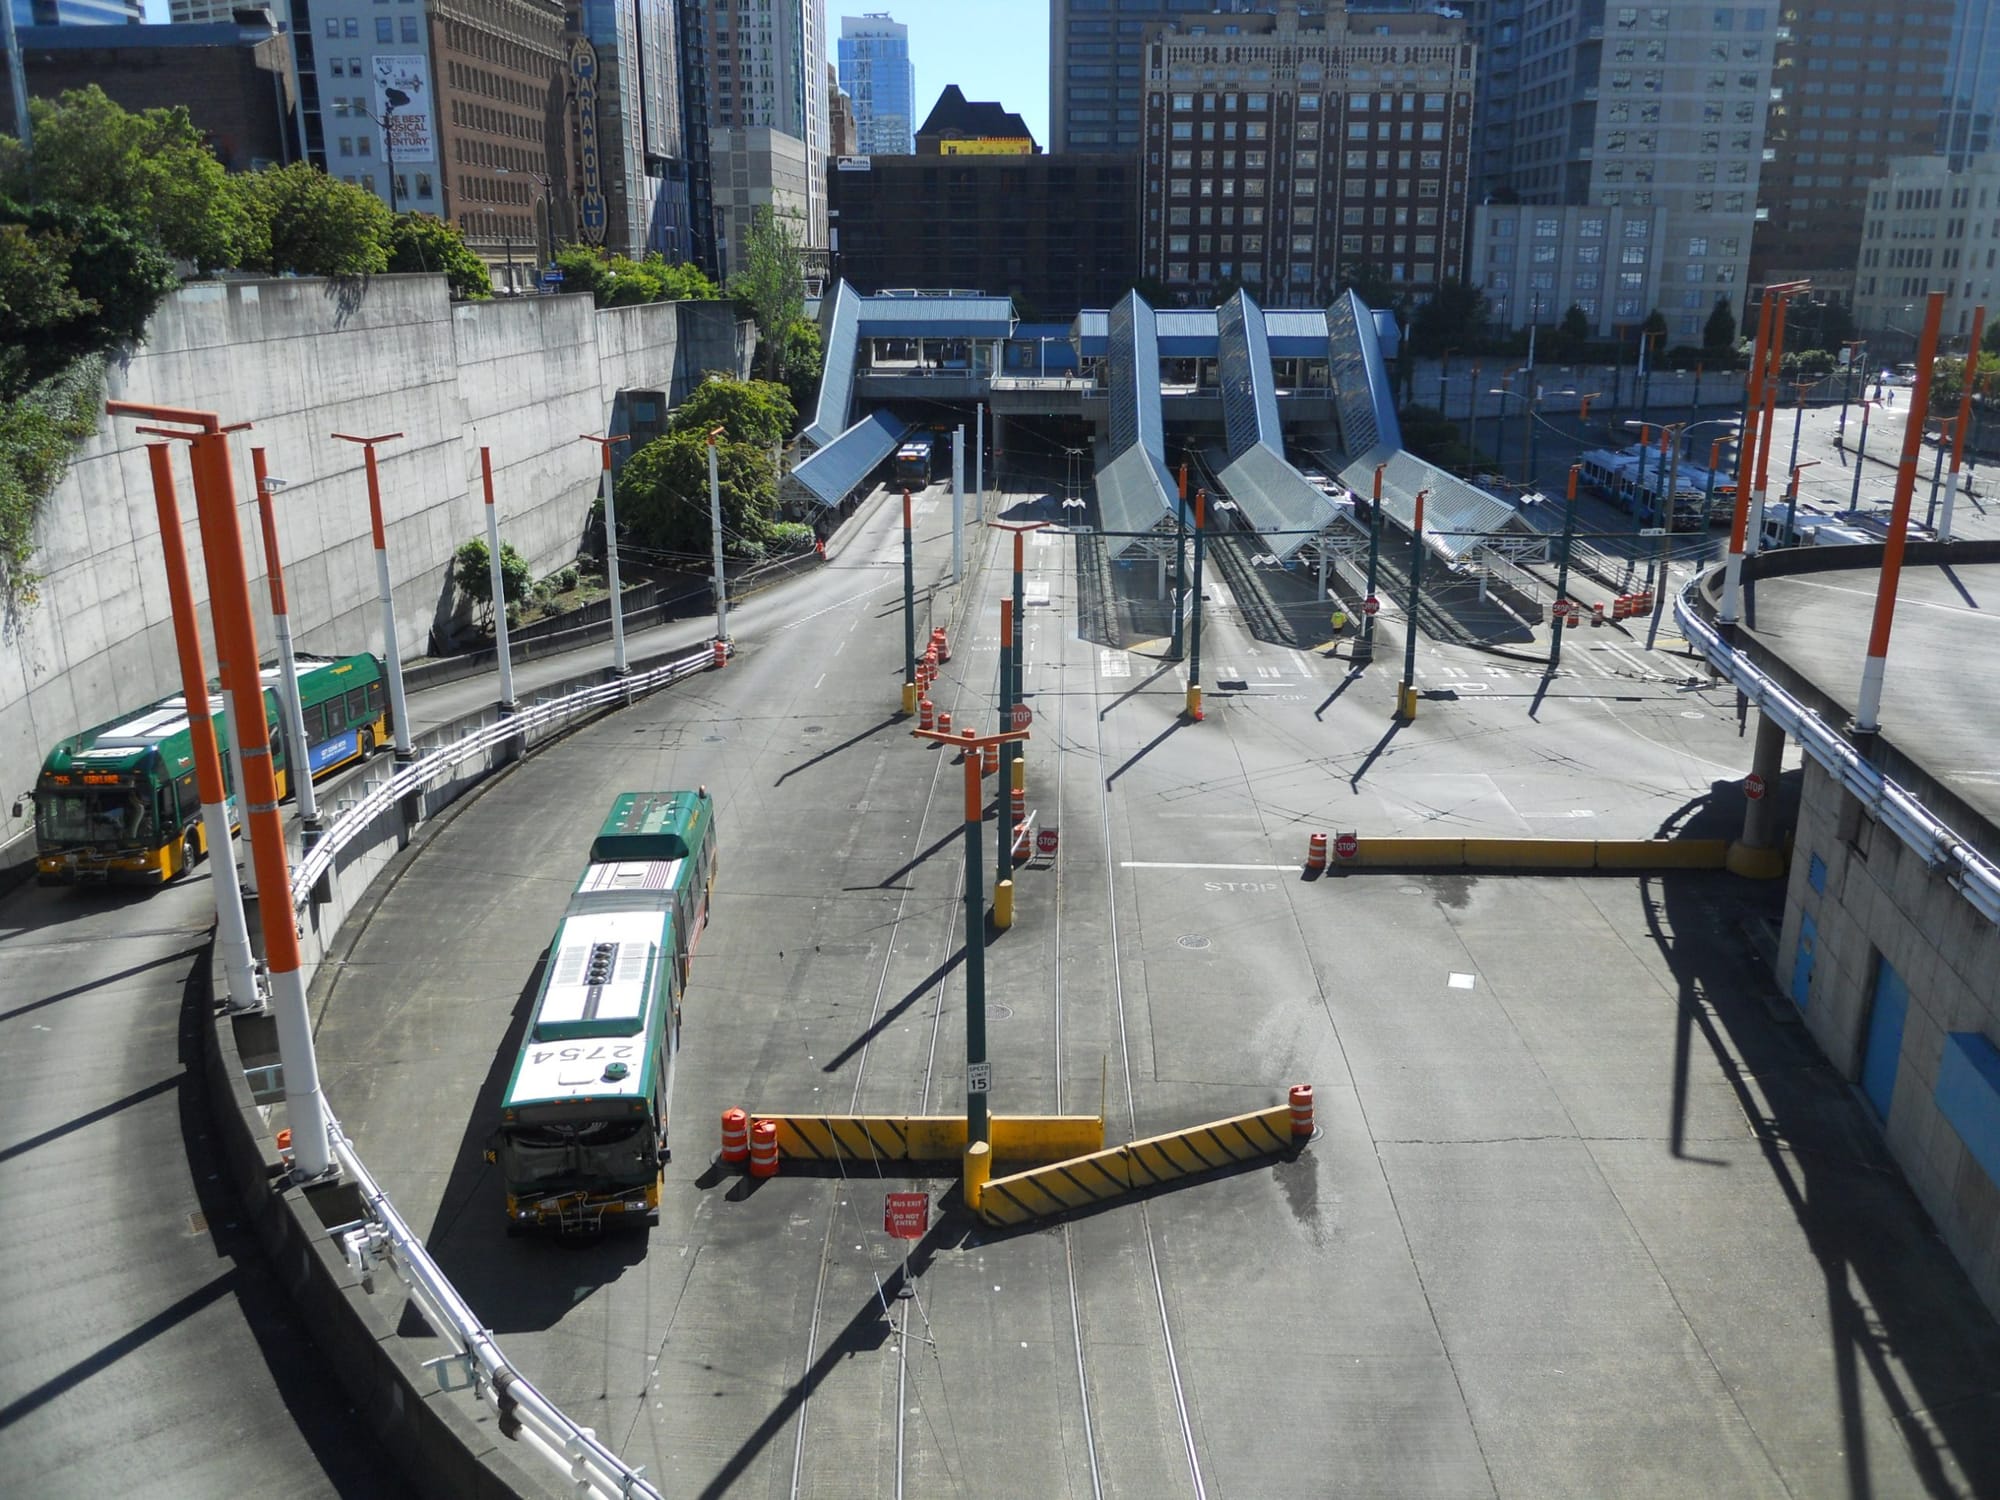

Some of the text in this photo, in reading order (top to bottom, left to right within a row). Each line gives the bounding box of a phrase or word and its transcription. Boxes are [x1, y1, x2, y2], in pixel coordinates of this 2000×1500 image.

[577, 54, 600, 226] PARAMOUNT
[1012, 712, 1031, 722] TOP
[1744, 781, 1763, 792] STOP
[1038, 836, 1058, 847] STOP
[1337, 842, 1357, 851] STOP
[1203, 881, 1278, 893] STOP
[531, 1045, 634, 1065] 2754
[969, 1064, 989, 1072] SPEED
[971, 1078, 987, 1090] 15
